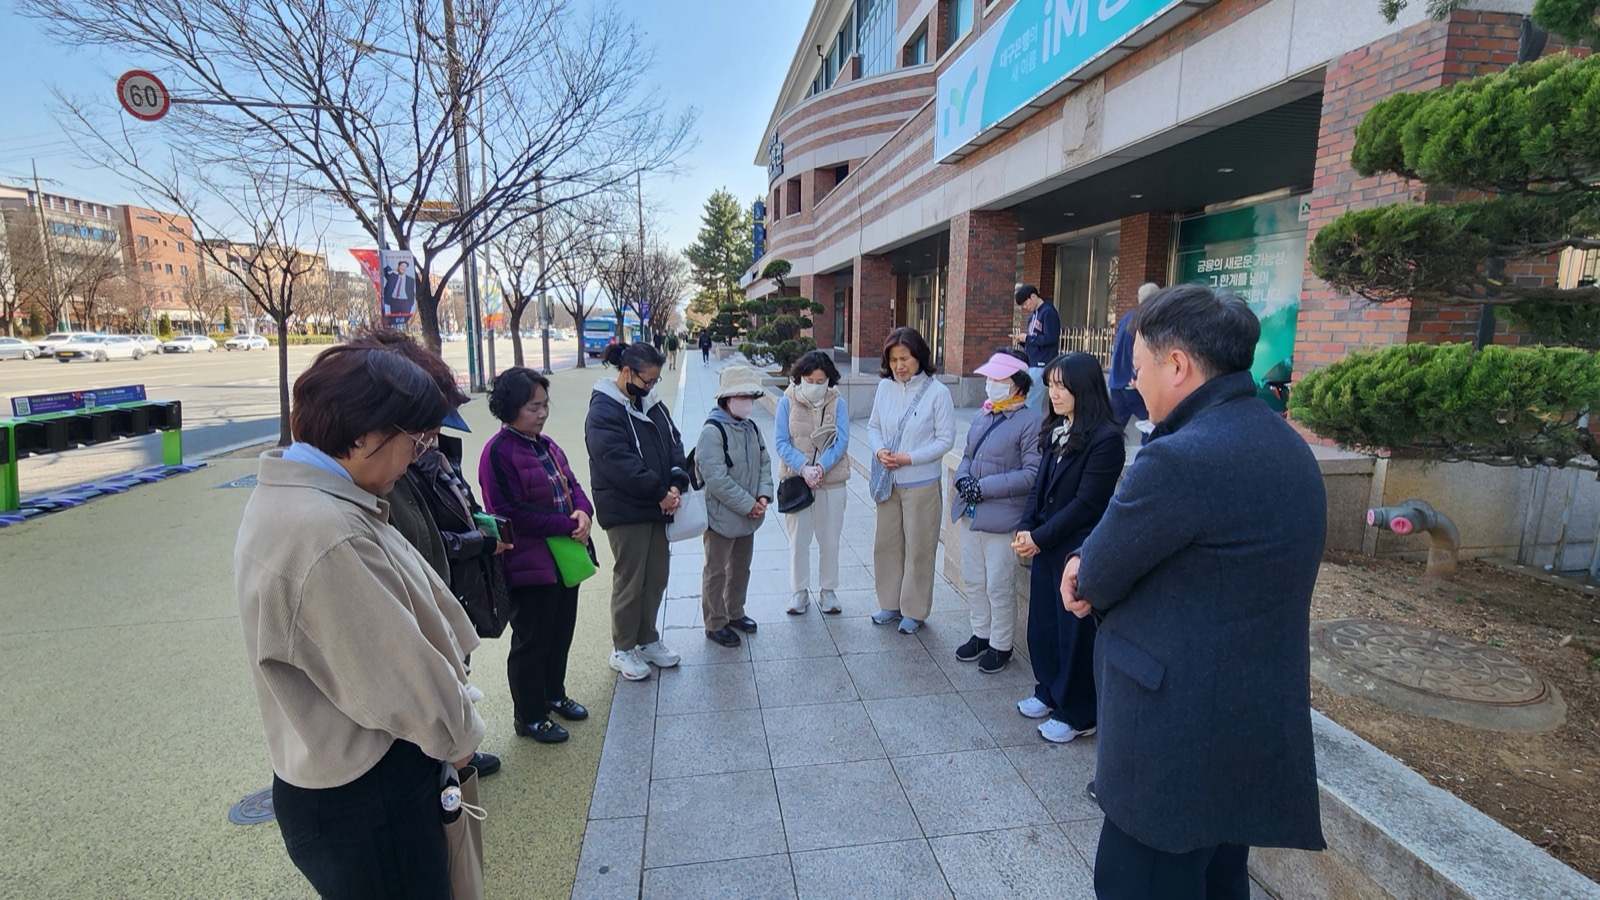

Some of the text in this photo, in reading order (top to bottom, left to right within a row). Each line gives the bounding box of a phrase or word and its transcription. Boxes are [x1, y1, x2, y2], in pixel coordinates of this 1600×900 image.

[1000, 23, 1038, 68] 대구은행의
[1011, 50, 1037, 82] 새 이름
[130, 85, 157, 107] 60
[1197, 258, 1223, 273] 금융의
[1224, 255, 1253, 270] 새로운
[1209, 271, 1269, 288] 그 한계를 넘어
